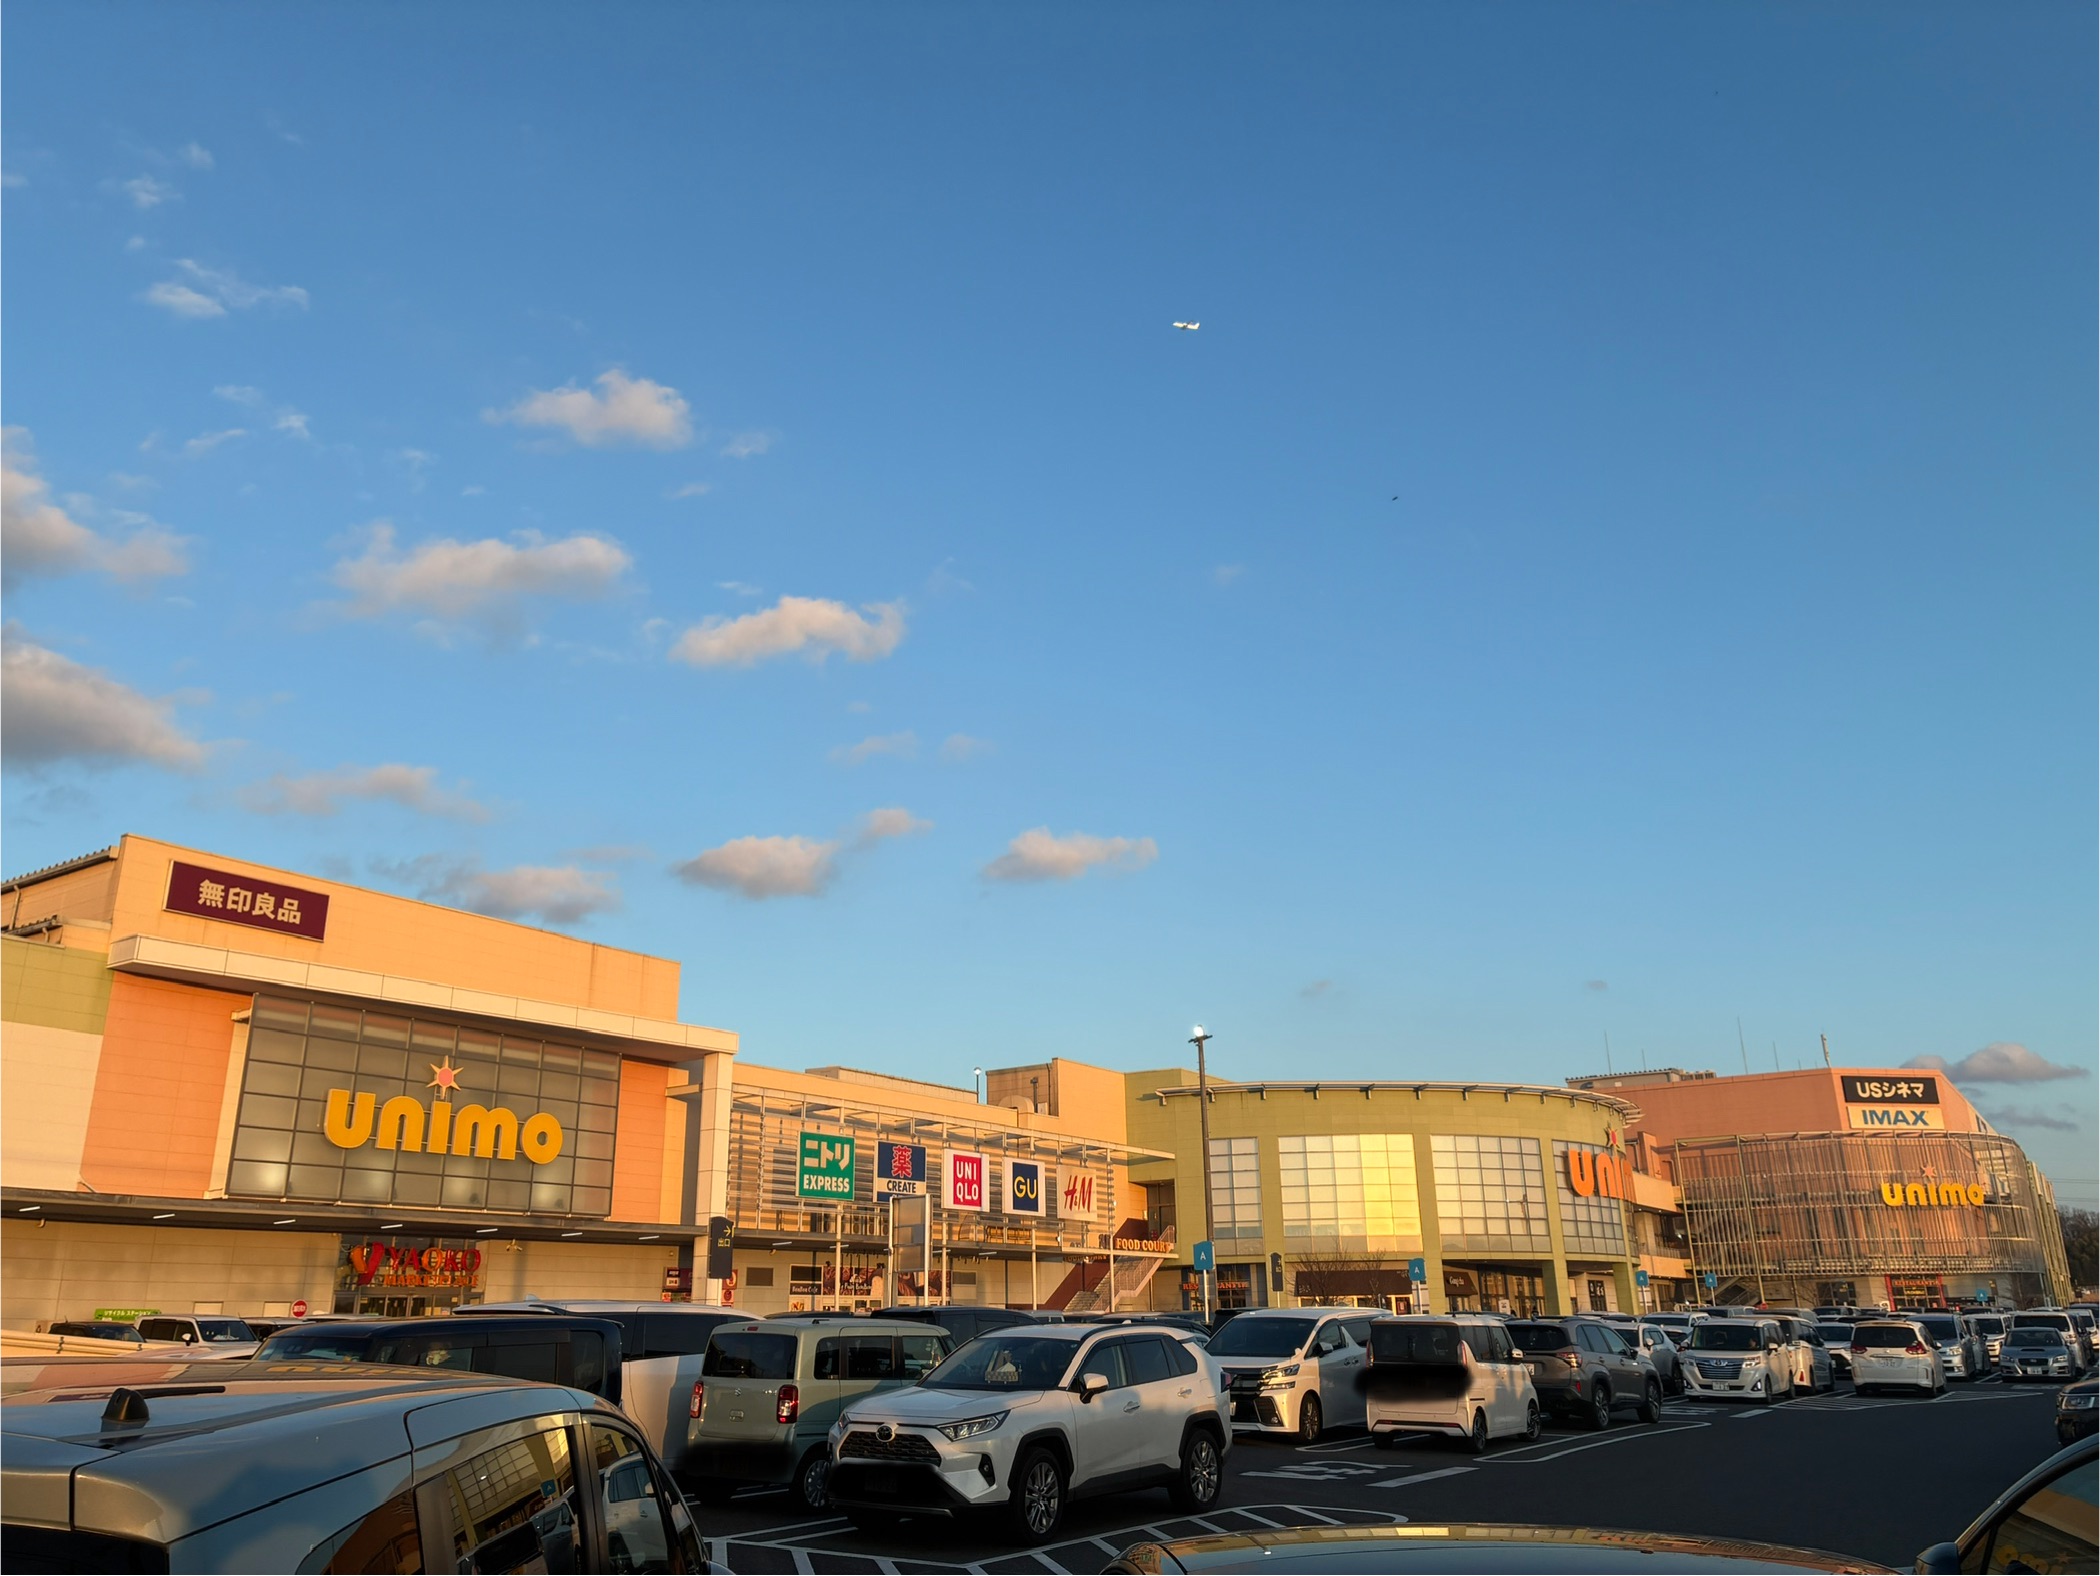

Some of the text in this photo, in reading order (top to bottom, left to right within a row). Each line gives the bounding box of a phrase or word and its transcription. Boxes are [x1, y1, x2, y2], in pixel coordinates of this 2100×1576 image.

[197, 879, 302, 925] 無印良品
[1856, 1081, 1924, 1099] USシネマ
[323, 1088, 564, 1165] unimo
[1862, 1109, 1930, 1127] IMAX
[803, 1139, 850, 1171] ニトリ
[891, 1144, 913, 1179] 薬
[955, 1160, 977, 1181] UNI
[803, 1173, 850, 1193] EXPRESS
[886, 1179, 917, 1194] CREATE
[955, 1182, 979, 1203] QLO
[1013, 1175, 1038, 1200] GU
[1063, 1174, 1093, 1213] H&M
[1880, 1182, 1985, 1207] unimo
[717, 1237, 731, 1248] 出口
[1115, 1237, 1141, 1251] FOOD
[389, 1246, 482, 1273] YAOKO
[1200, 1251, 1207, 1260] A
[1414, 1266, 1420, 1274] A
